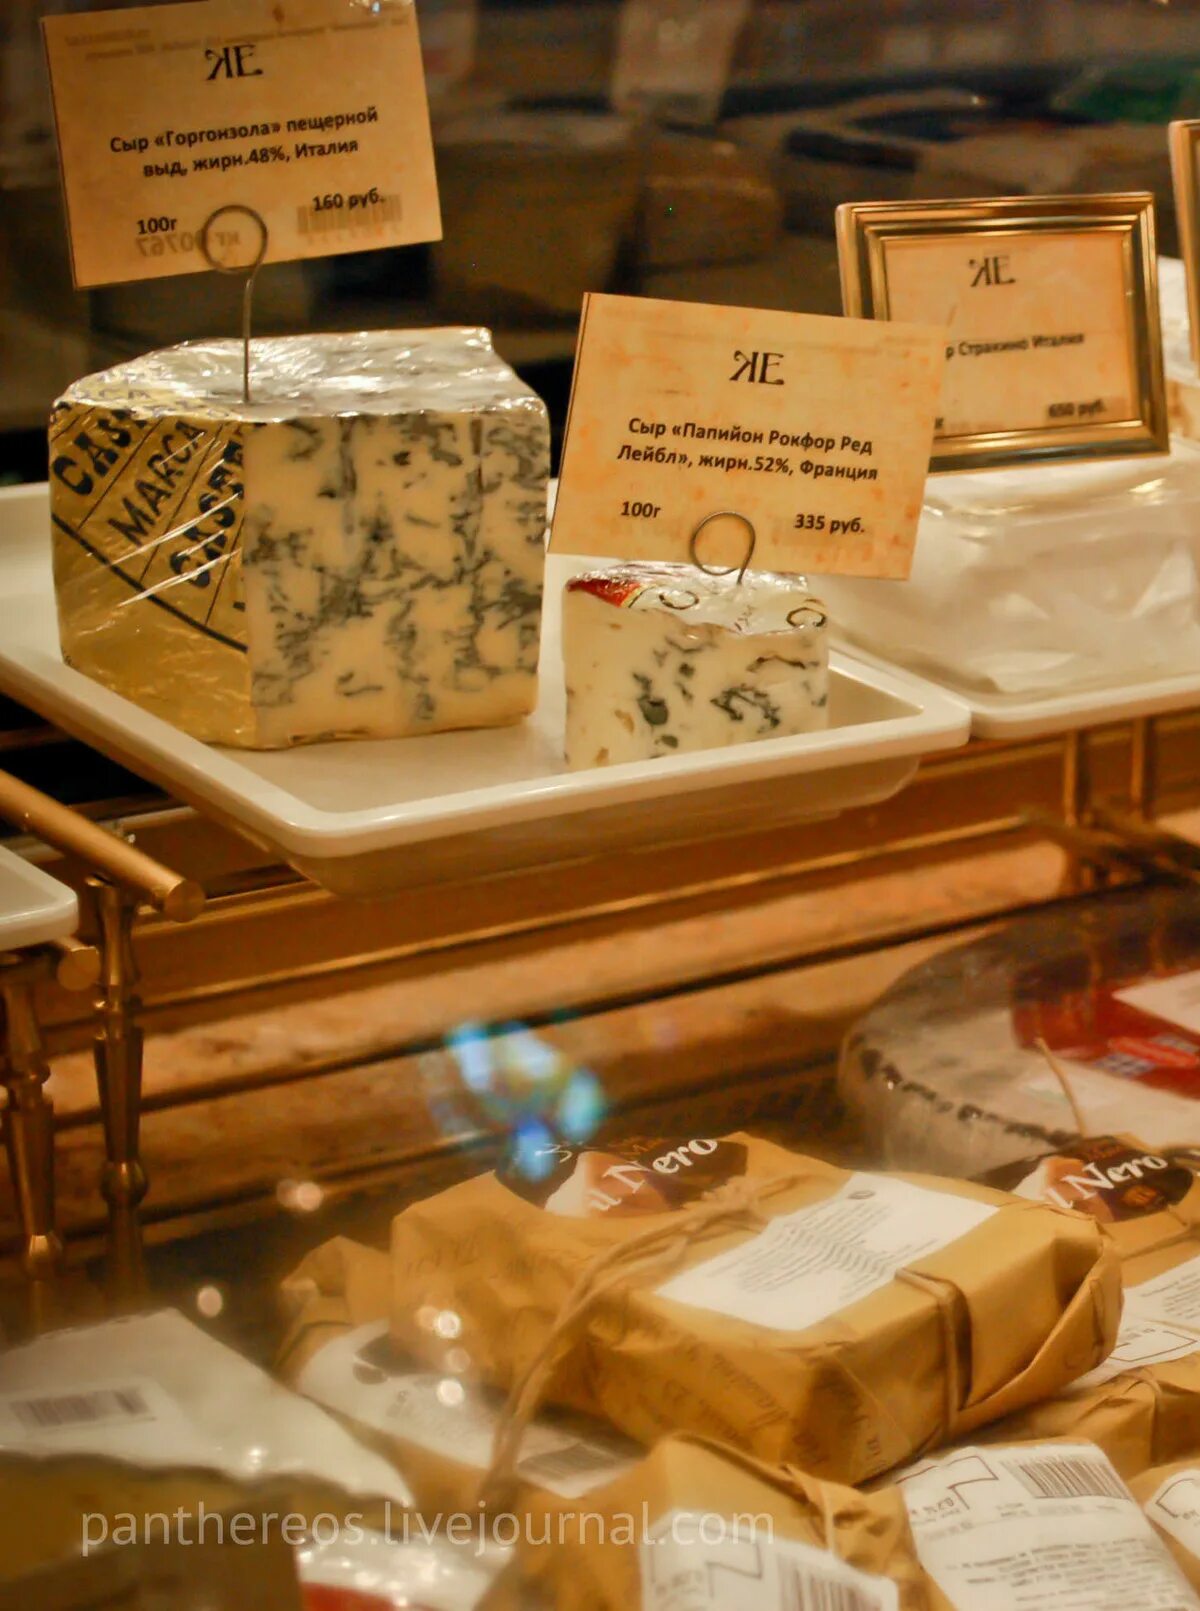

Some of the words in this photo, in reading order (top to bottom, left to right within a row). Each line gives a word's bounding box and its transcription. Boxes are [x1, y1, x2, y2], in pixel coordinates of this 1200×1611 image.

[110, 135, 150, 154] Сыр
[154, 122, 282, 149] «Горгонзола»
[287, 106, 379, 135] пещерной
[193, 146, 291, 173] жирн.48%,
[295, 139, 359, 160] Италия
[313, 192, 343, 211] 160
[348, 187, 386, 211] руб.
[136, 217, 177, 235] 100г
[628, 418, 666, 437] Сыр
[672, 422, 763, 445] «Папийон
[768, 429, 835, 452] Рокфор
[840, 435, 872, 456] Ред
[617, 444, 693, 467] Лейбл»,
[698, 453, 794, 476] жирн.52%,
[799, 460, 877, 482] Франция
[108, 421, 208, 547] MARCA
[620, 501, 661, 519] 100г
[794, 514, 825, 532] 335
[829, 515, 866, 535] руб.
[602, 1138, 717, 1194] Nero
[1061, 1153, 1168, 1199] Nero
